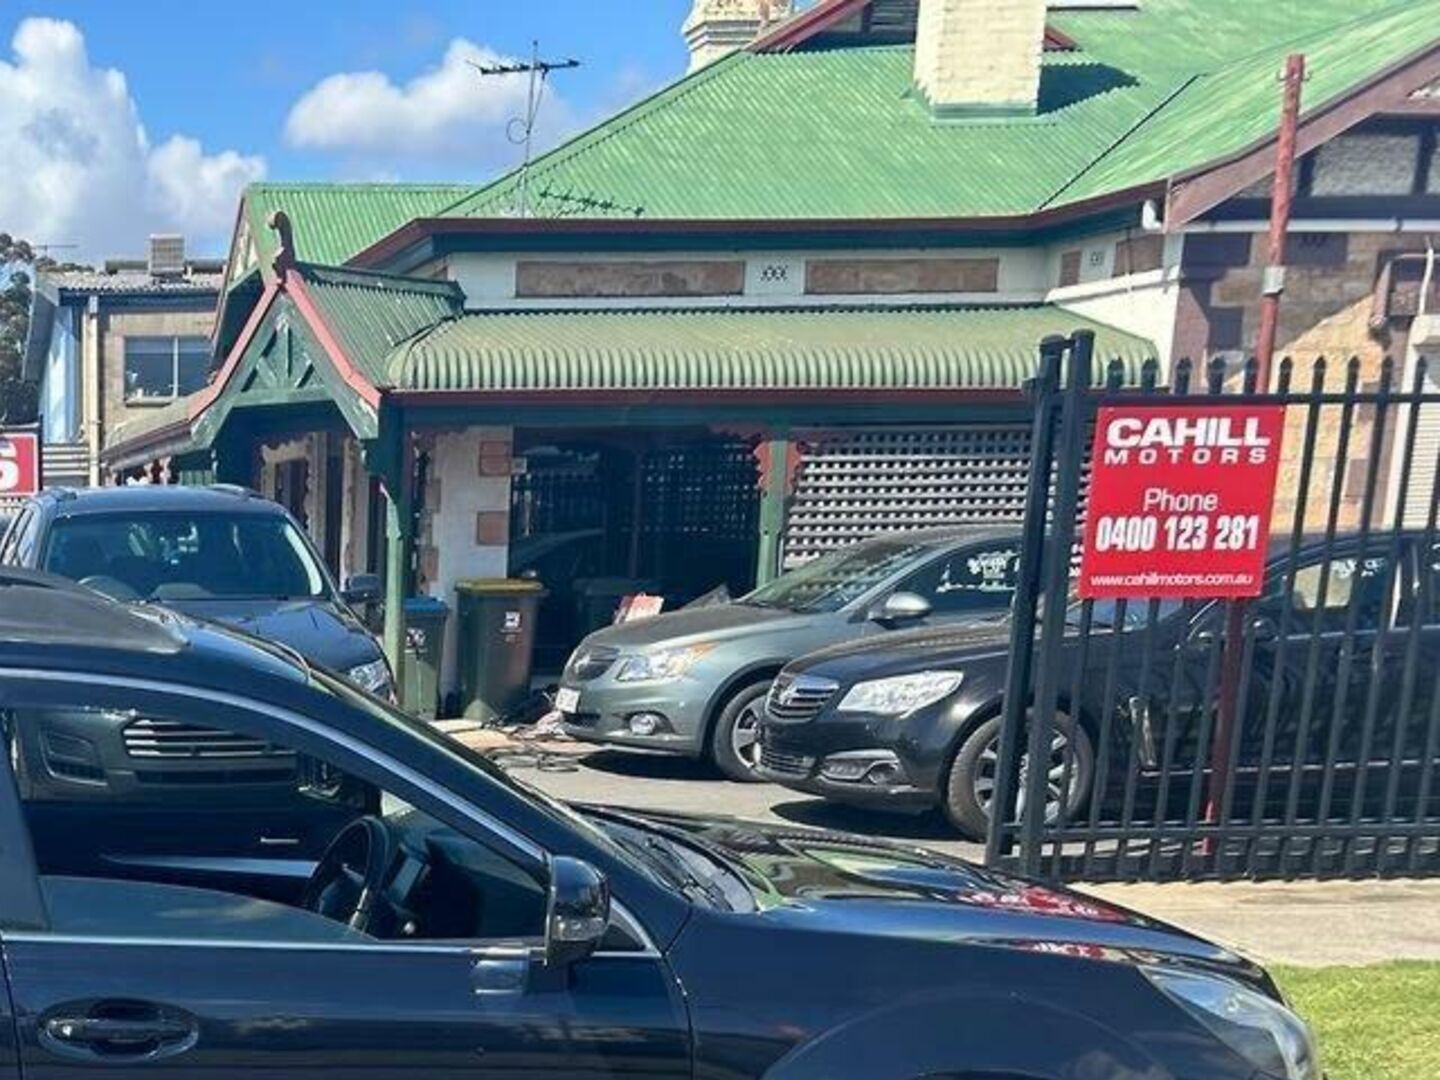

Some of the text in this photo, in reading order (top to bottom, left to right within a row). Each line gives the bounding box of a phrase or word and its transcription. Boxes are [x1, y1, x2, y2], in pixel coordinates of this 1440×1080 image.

[1106, 417, 1271, 448] CAHILL
[1103, 446, 1267, 465] MOTORS
[1143, 488, 1219, 512] Phone
[1094, 515, 1259, 552] 0400 123 281
[1090, 573, 1254, 587] www.cahillmotors.com.au
